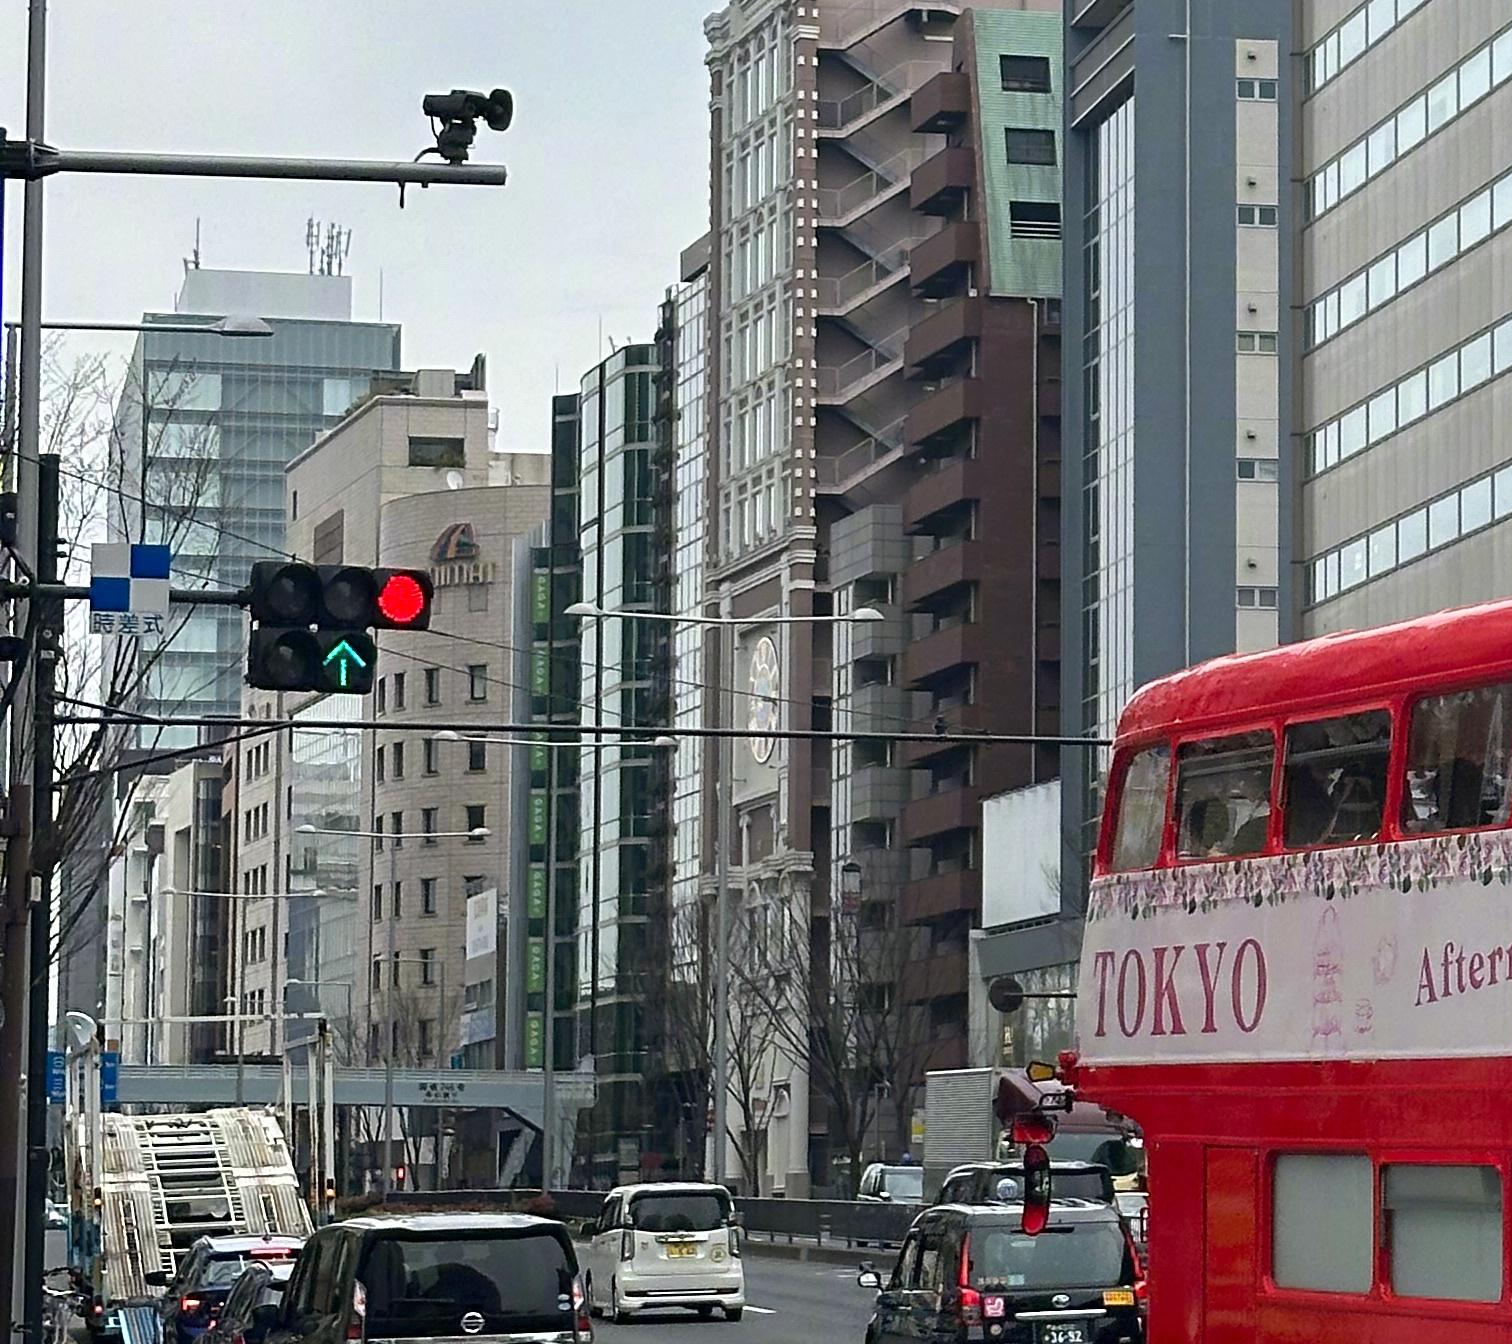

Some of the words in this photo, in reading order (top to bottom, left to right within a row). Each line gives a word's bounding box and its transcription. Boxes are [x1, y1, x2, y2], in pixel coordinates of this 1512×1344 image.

[93, 613, 164, 635] 時差式
[1093, 938, 1267, 1038] TOKYO
